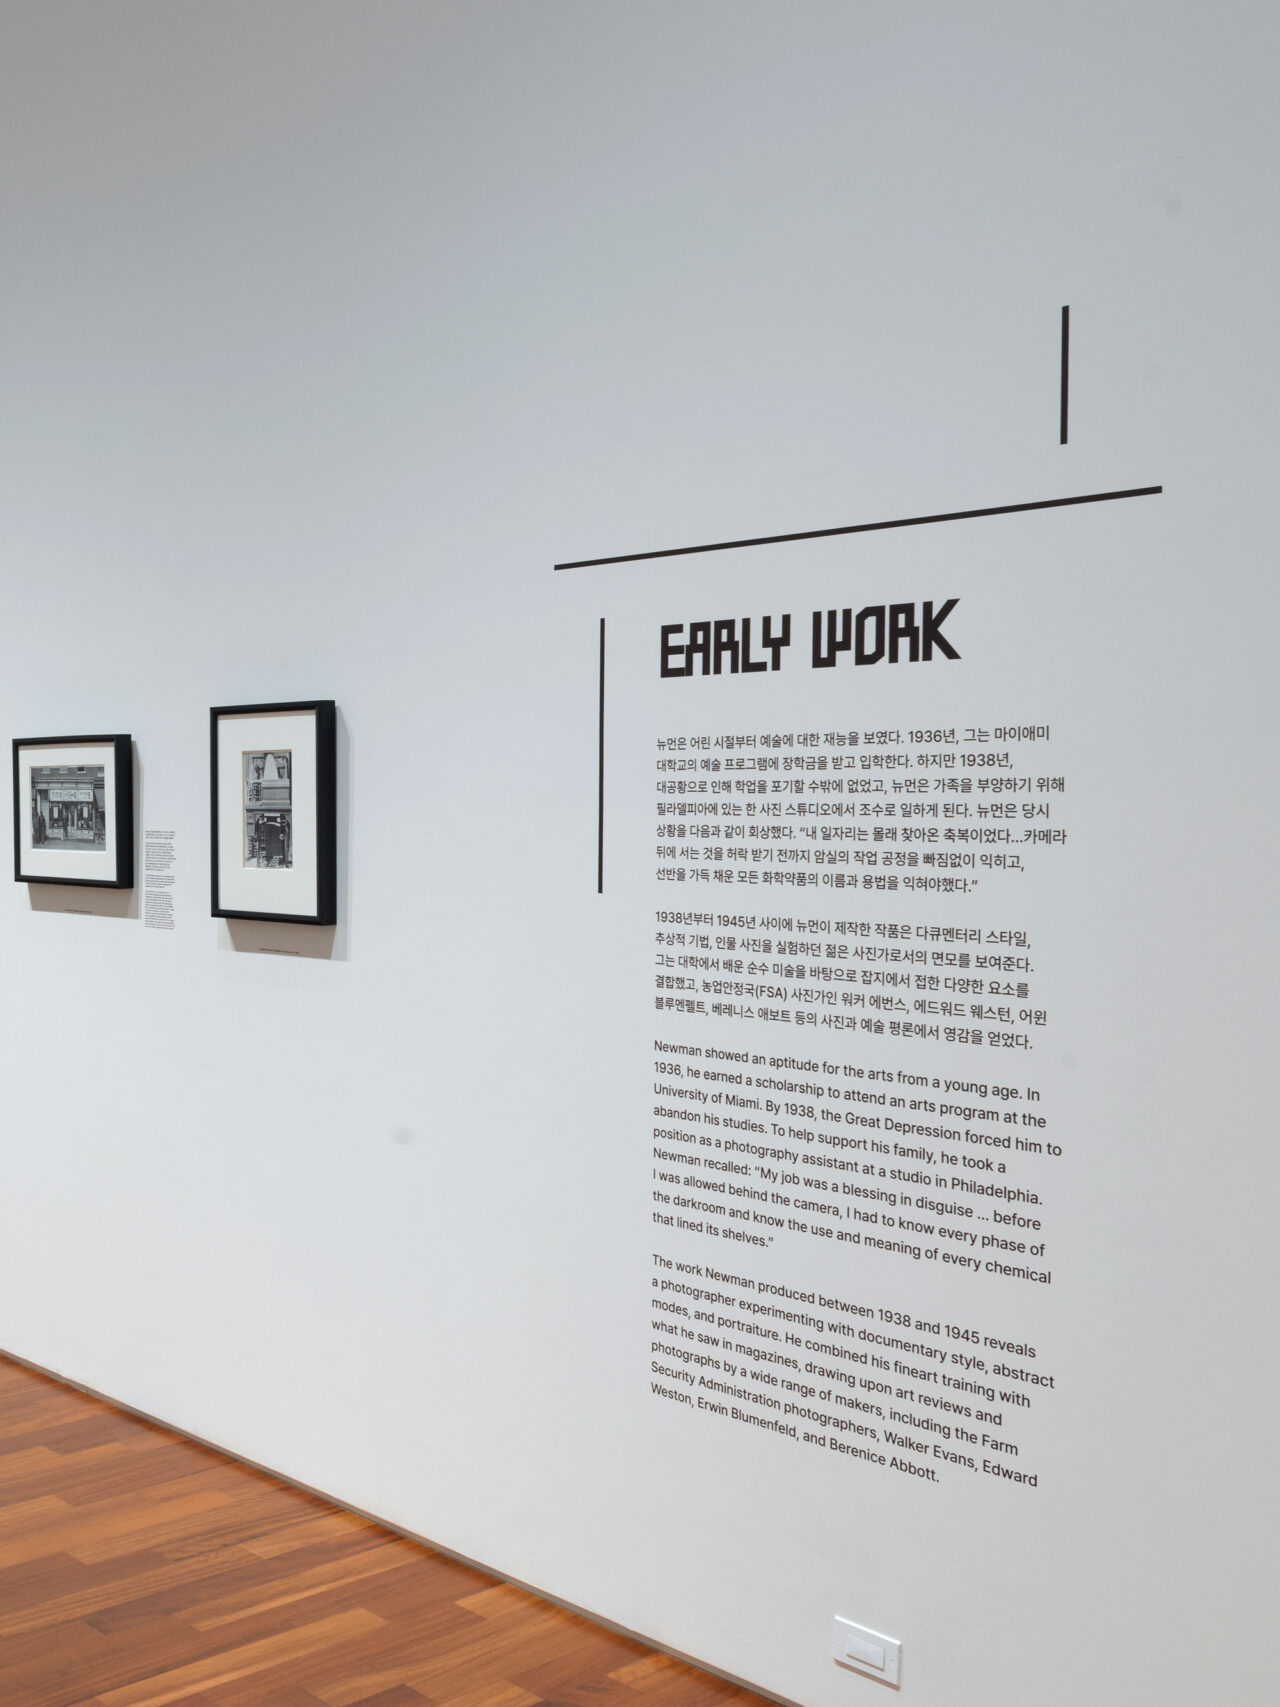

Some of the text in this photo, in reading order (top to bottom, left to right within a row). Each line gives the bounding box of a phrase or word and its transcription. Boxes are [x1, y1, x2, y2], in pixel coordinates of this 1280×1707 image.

[661, 598, 962, 678] EARLY WORK
[656, 724, 1049, 750] 뉴먼은 어린 시절부터 예술에 대한 재능을 보였다. 1936년, 그는 마이애미
[656, 776, 1064, 795] 대공황으로 인해 학업을 포기할 수밖에 없었고, 뉴먼은 가족을 부양하기 위해
[656, 823, 686, 837] 상황을
[689, 824, 721, 838] 다음과
[723, 824, 744, 838] 같이
[748, 824, 796, 839] 회상했다.
[820, 825, 869, 841] 일자리는
[688, 868, 710, 882] 가득
[712, 868, 734, 883] 채운
[736, 870, 759, 884] 모든
[761, 870, 818, 887] 화학약품의
[822, 872, 858, 888] 이름과
[861, 874, 899, 890] 용법을
[654, 931, 685, 946] 추상적
[688, 933, 712, 950] 기법,
[715, 935, 736, 950] 인물
[739, 937, 772, 953] 사진을
[775, 940, 821, 957] 실험하던
[852, 945, 926, 965] 사진가로서의
[931, 951, 971, 968] 면모를
[974, 954, 1034, 973] 보여준다.
[654, 974, 1046, 1026] 결합했고, 농업안정국(FSA) 사진가인 워커 에번스, 에드워드 웨스턴, 어윈
[653, 1039, 702, 1056] Newman
[704, 1046, 748, 1063] showed
[751, 1054, 766, 1065] an
[768, 1056, 819, 1072] aptitude
[821, 1060, 840, 1075] for
[842, 1064, 864, 1078] the
[867, 1069, 893, 1082] arts
[896, 1070, 928, 1087] from
[943, 1079, 987, 1098] young
[991, 1085, 1022, 1100] age.
[1026, 1087, 1039, 1101] In
[653, 1082, 1062, 1156] University of Miami. By 1938, the Great Depression forced him to
[653, 1127, 696, 1143] position
[698, 1135, 712, 1146] as
[724, 1139, 799, 1164] photography
[801, 1153, 858, 1173] assistant
[861, 1163, 875, 1175] at
[889, 1168, 931, 1185] studio
[935, 1173, 947, 1188] in
[951, 1176, 1042, 1205] Philadelphia.
[653, 1146, 700, 1166] Newman
[703, 1158, 751, 1176] recalled:
[780, 1169, 800, 1185] job
[802, 1176, 828, 1190] was
[842, 1181, 896, 1206] blessing
[900, 1191, 911, 1206] in
[915, 1196, 973, 1217] disguise
[993, 1209, 1041, 1230] before
[652, 1211, 674, 1226] that
[676, 1216, 703, 1232] lined
[705, 1222, 719, 1236] its
[652, 1190, 1051, 1284] the darkroom and know the use and meaning of every chemical
[651, 1253, 1036, 1358] The work Newman produced between 1938 and 1945 reveals
[660, 1279, 736, 1306] photographer
[738, 1299, 824, 1332] experimenting
[826, 1321, 854, 1338] with
[857, 1328, 947, 1363] documentary
[950, 1353, 988, 1375] style,
[992, 1362, 1054, 1389] abstract
[651, 1319, 1002, 1426] what he saw in magazines, drawing upon art reviews and
[650, 1360, 1037, 1487] Security Administration photographers, Walker Evans, Edward
